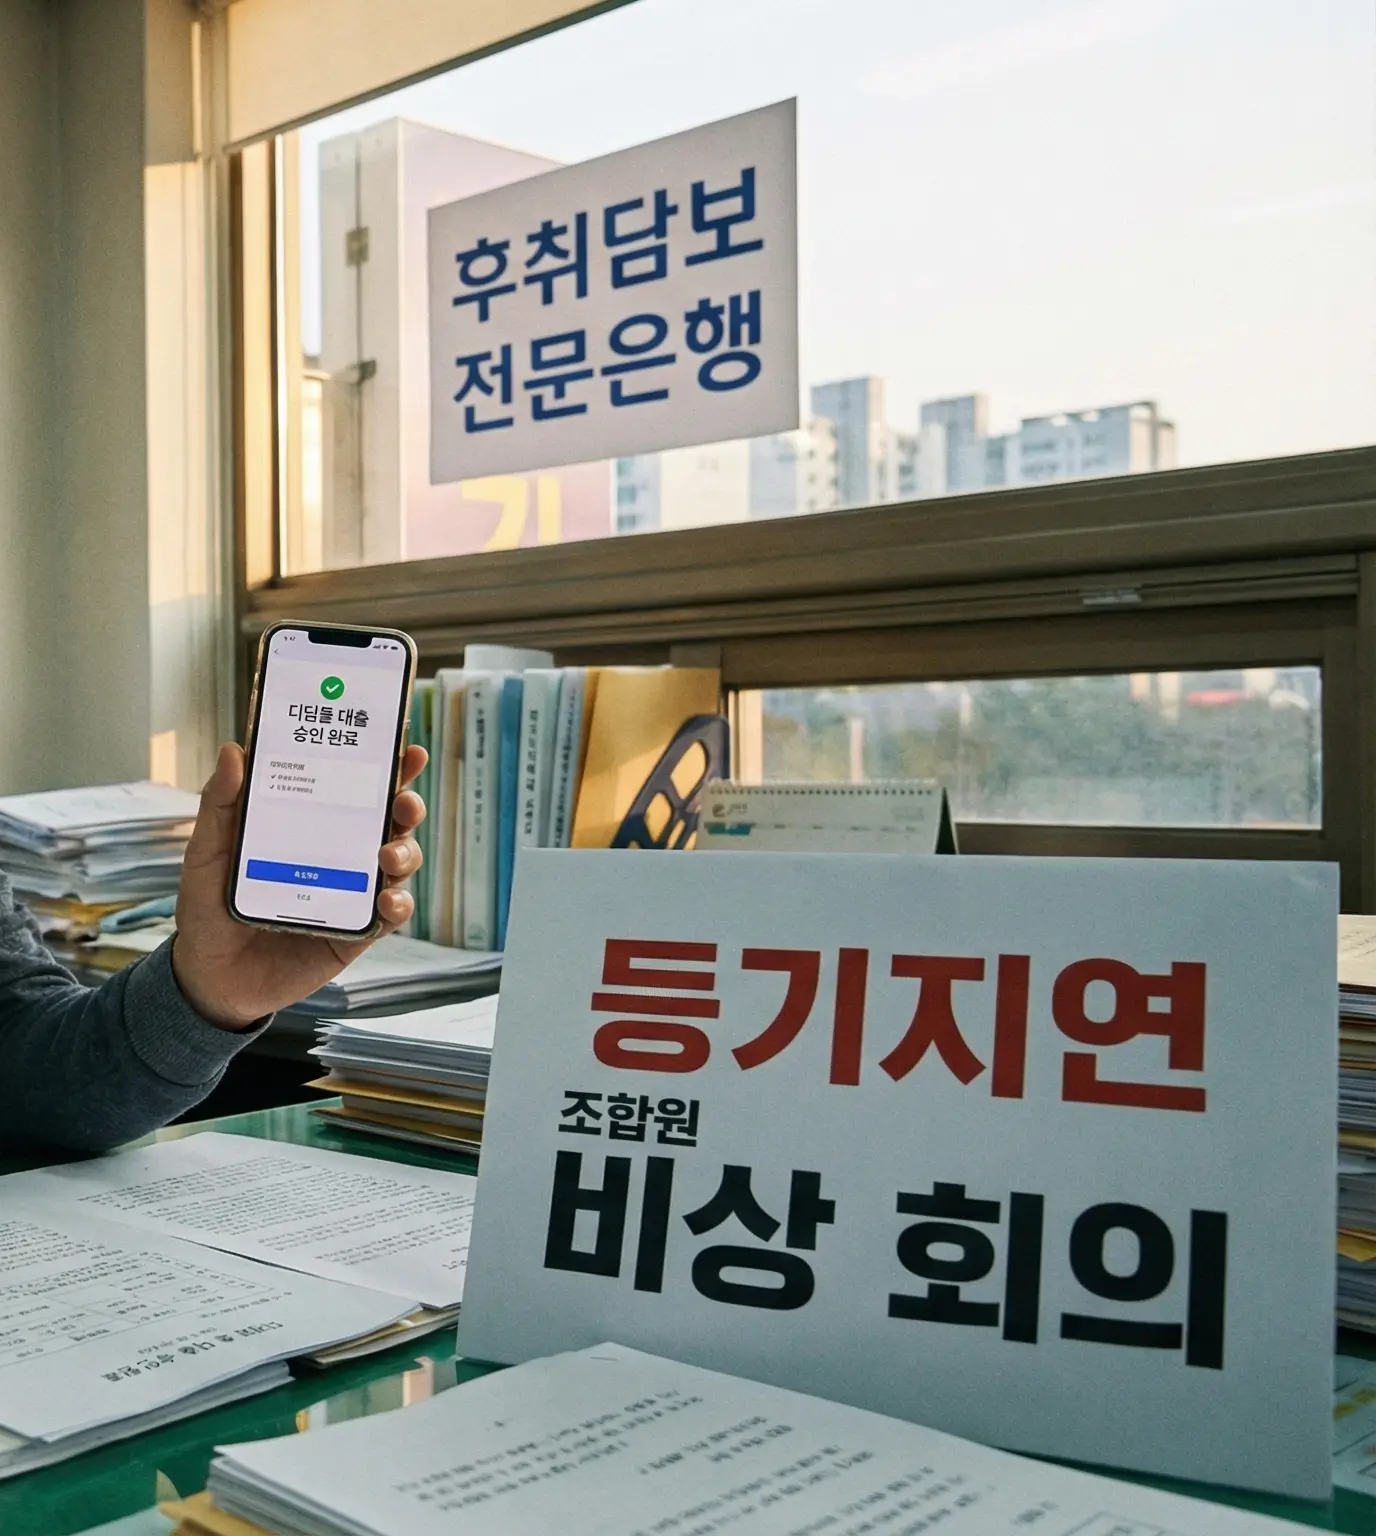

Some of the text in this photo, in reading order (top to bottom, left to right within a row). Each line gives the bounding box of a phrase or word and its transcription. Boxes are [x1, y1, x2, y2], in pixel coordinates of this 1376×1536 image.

[452, 166, 764, 323] 후취담보
[452, 289, 762, 434] 전문은행
[293, 726, 323, 744] 승인
[590, 938, 1206, 1112] 등기지연
[558, 1090, 700, 1147] 조합원
[543, 1150, 836, 1311] 비상
[887, 1181, 1229, 1371] 회의
